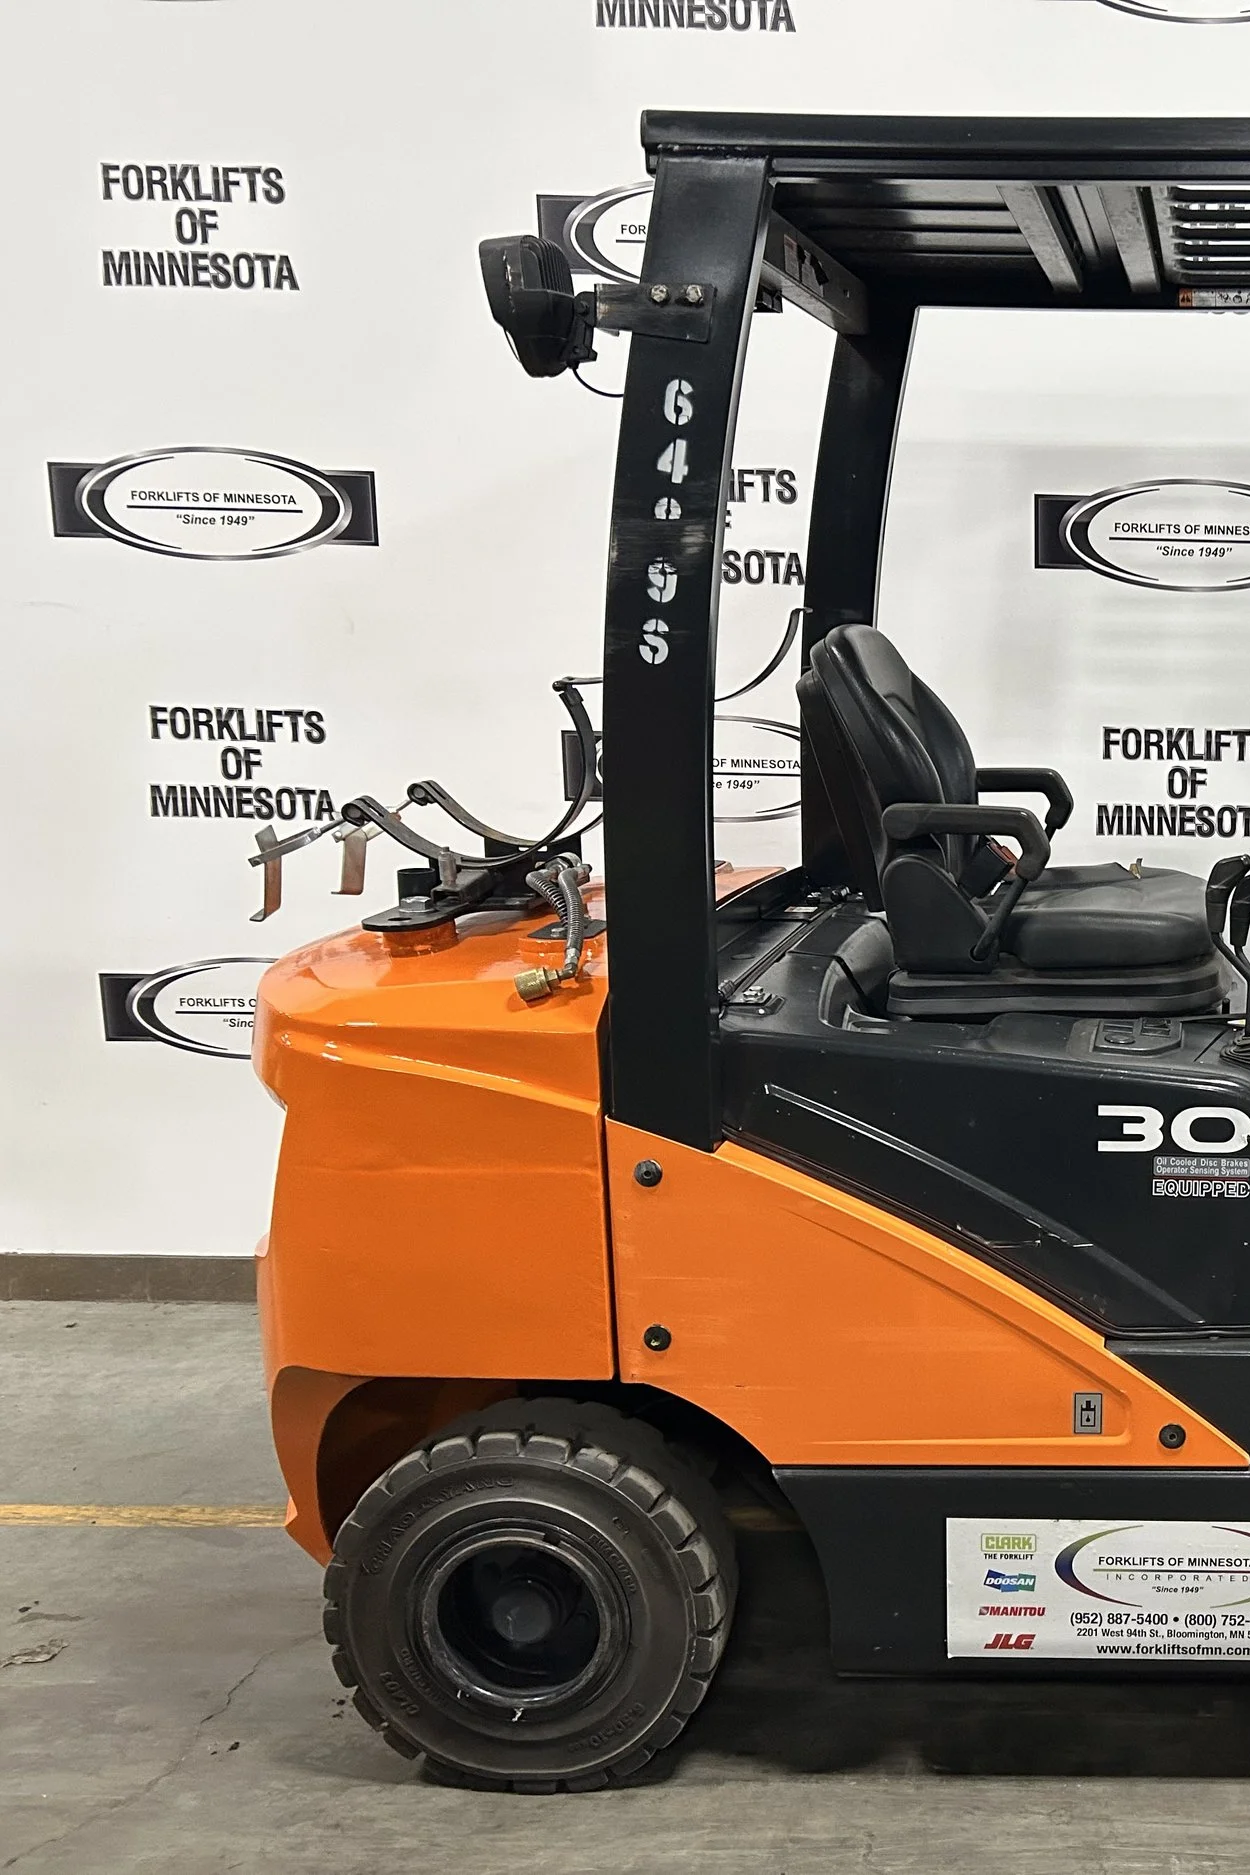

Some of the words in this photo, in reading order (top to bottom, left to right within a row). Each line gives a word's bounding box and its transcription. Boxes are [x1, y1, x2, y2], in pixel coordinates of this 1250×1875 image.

[596, 0, 796, 32] MINNESOTA
[101, 163, 285, 204] FORKLIFTS
[176, 207, 219, 245] OF
[103, 250, 300, 290] MINNESOTA
[131, 491, 201, 503] FORKLIFTS
[203, 493, 219, 502] OF
[224, 493, 296, 504] MINNESOTA
[177, 514, 216, 525] “Since
[220, 516, 254, 526] 1949”
[1113, 523, 1181, 535] FORKLIFTS
[1185, 525, 1200, 534] OF
[1157, 546, 1194, 556] “Since
[1198, 546, 1233, 558] 1949”
[149, 705, 327, 744] FORKLIFTS
[221, 746, 262, 780] OF
[731, 758, 800, 769] MINNESOTA
[727, 780, 759, 789] 1949”
[1167, 766, 1208, 799] OF
[149, 784, 334, 822] MINNESOTA
[180, 998, 245, 1007] FORKLIFTS
[223, 1018, 254, 1028] “Sinc
[1155, 1157, 1168, 1167] Oil
[1170, 1157, 1197, 1167] Cooled
[1200, 1158, 1218, 1167] Disc
[1221, 1158, 1248, 1168] Brakes
[1155, 1165, 1188, 1176] Operator
[1189, 1166, 1219, 1177] Sensing
[1221, 1166, 1248, 1177] System
[1152, 1179, 1250, 1198] EQUIPPED
[985, 1536, 1032, 1550] CLARK
[1099, 1557, 1164, 1566] FORKLIFTS
[1168, 1558, 1184, 1566] OF
[985, 1576, 1036, 1586] DOOSAN
[1106, 1573, 1249, 1583] INCORPORATED
[988, 1606, 1046, 1617] MANITOU
[1070, 1612, 1102, 1627] (952)
[1107, 1613, 1168, 1625] 887-5400
[1184, 1613, 1217, 1628] (800)
[1076, 1628, 1099, 1637] 2201
[1101, 1629, 1123, 1637] West
[1127, 1629, 1146, 1637] 94th
[1150, 1629, 1164, 1639] St.,
[1167, 1629, 1227, 1640] Bloomington,
[1230, 1630, 1244, 1638] MN
[984, 1634, 1035, 1650] JLG
